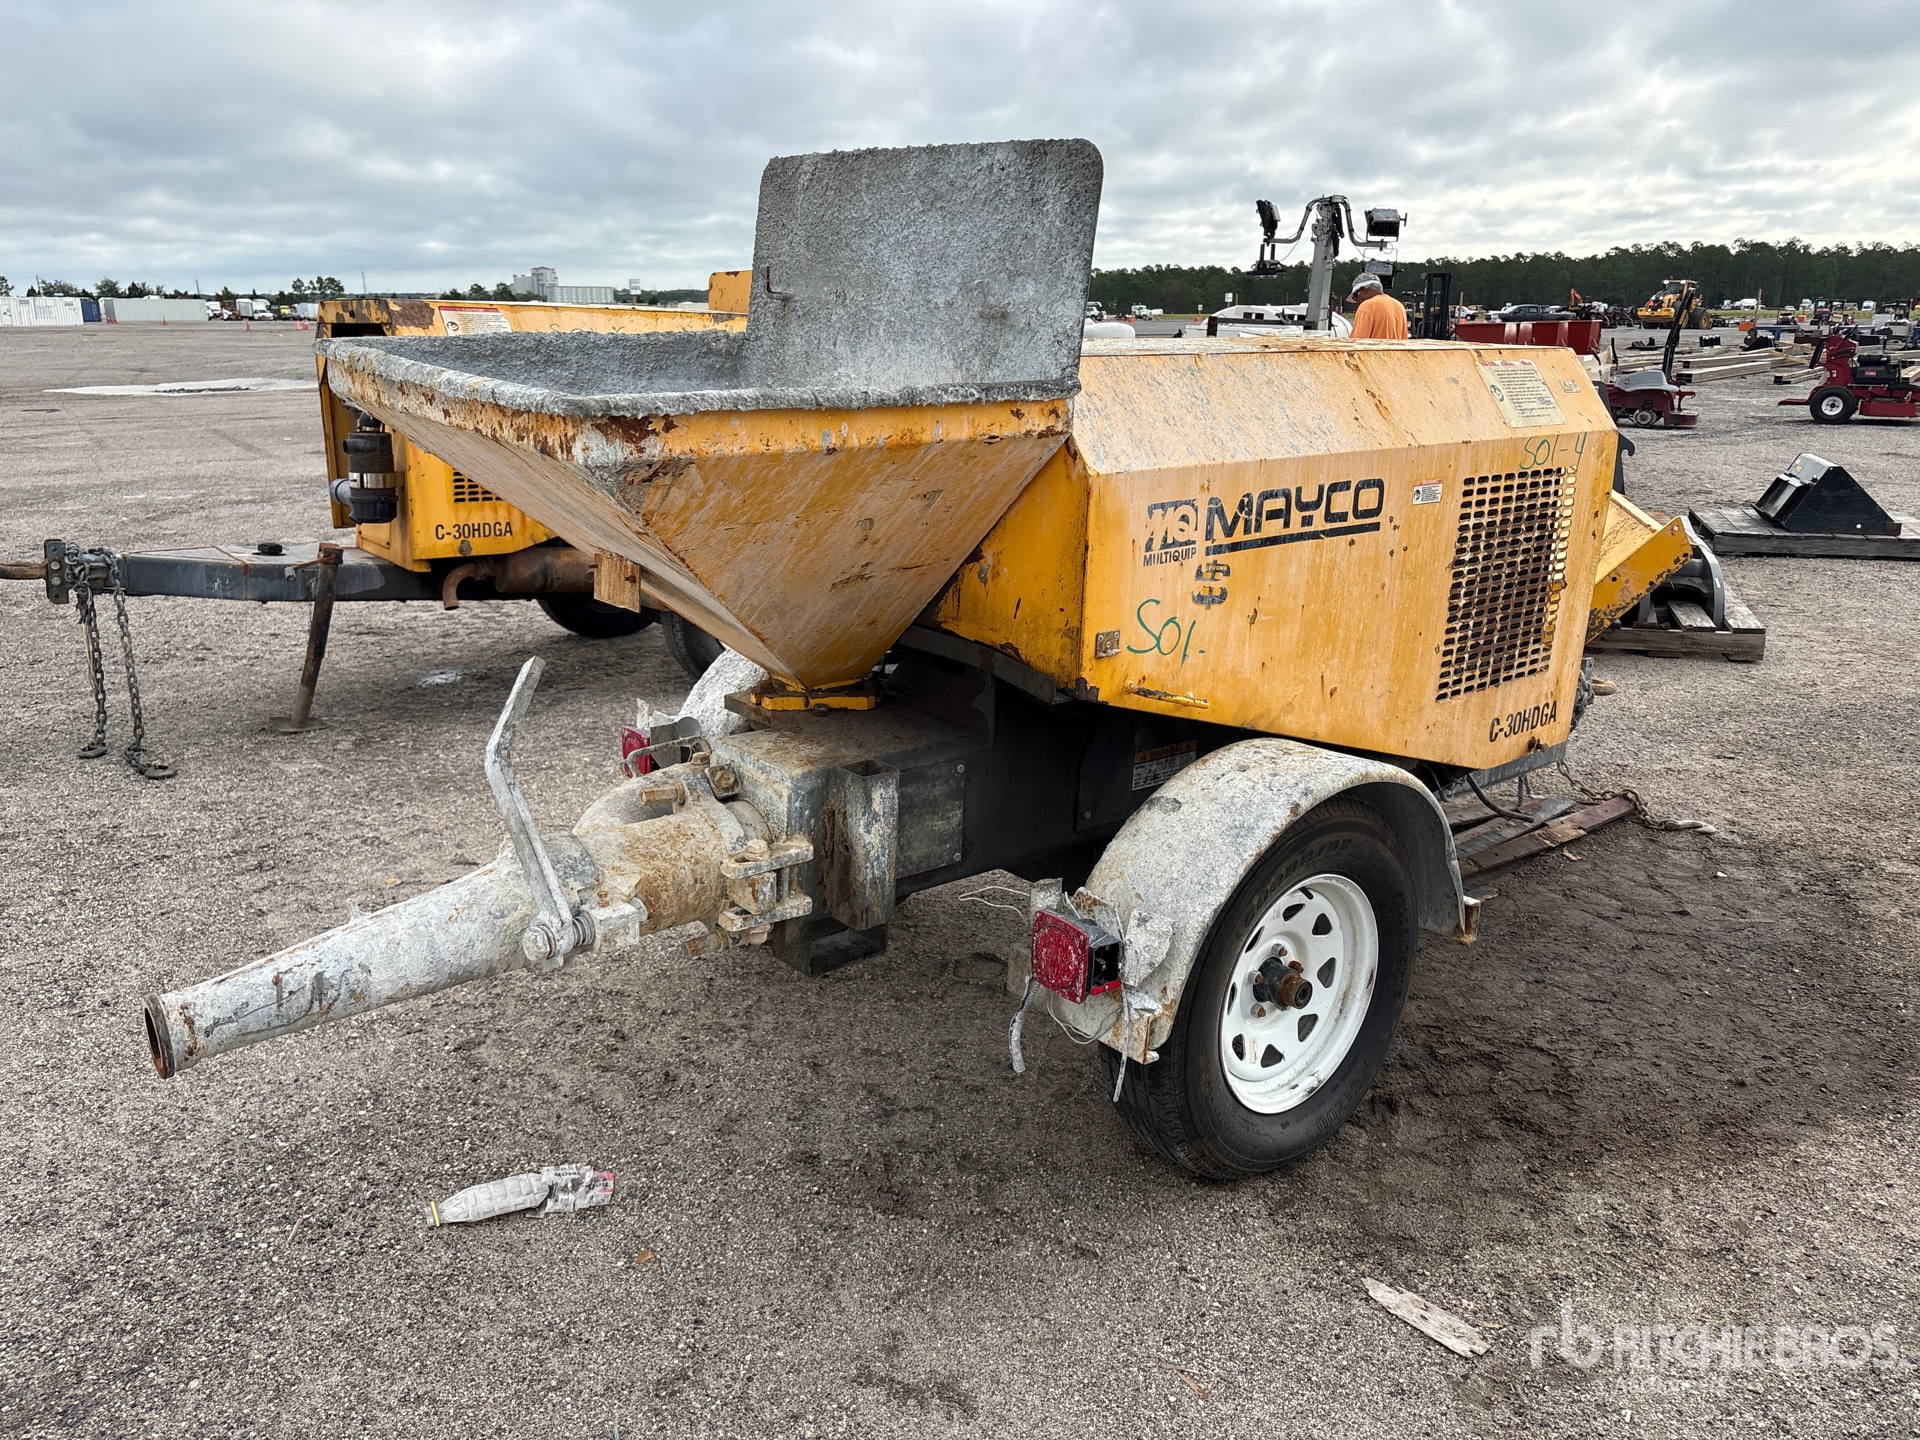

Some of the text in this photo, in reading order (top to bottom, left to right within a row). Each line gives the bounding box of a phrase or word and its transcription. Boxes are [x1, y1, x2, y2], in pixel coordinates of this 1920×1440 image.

[1204, 478, 1384, 541] MAYCO
[435, 521, 513, 540] C-30HDGA
[1143, 546, 1197, 567] MULTIQUIP
[1488, 700, 1557, 743] C-30HDGA
